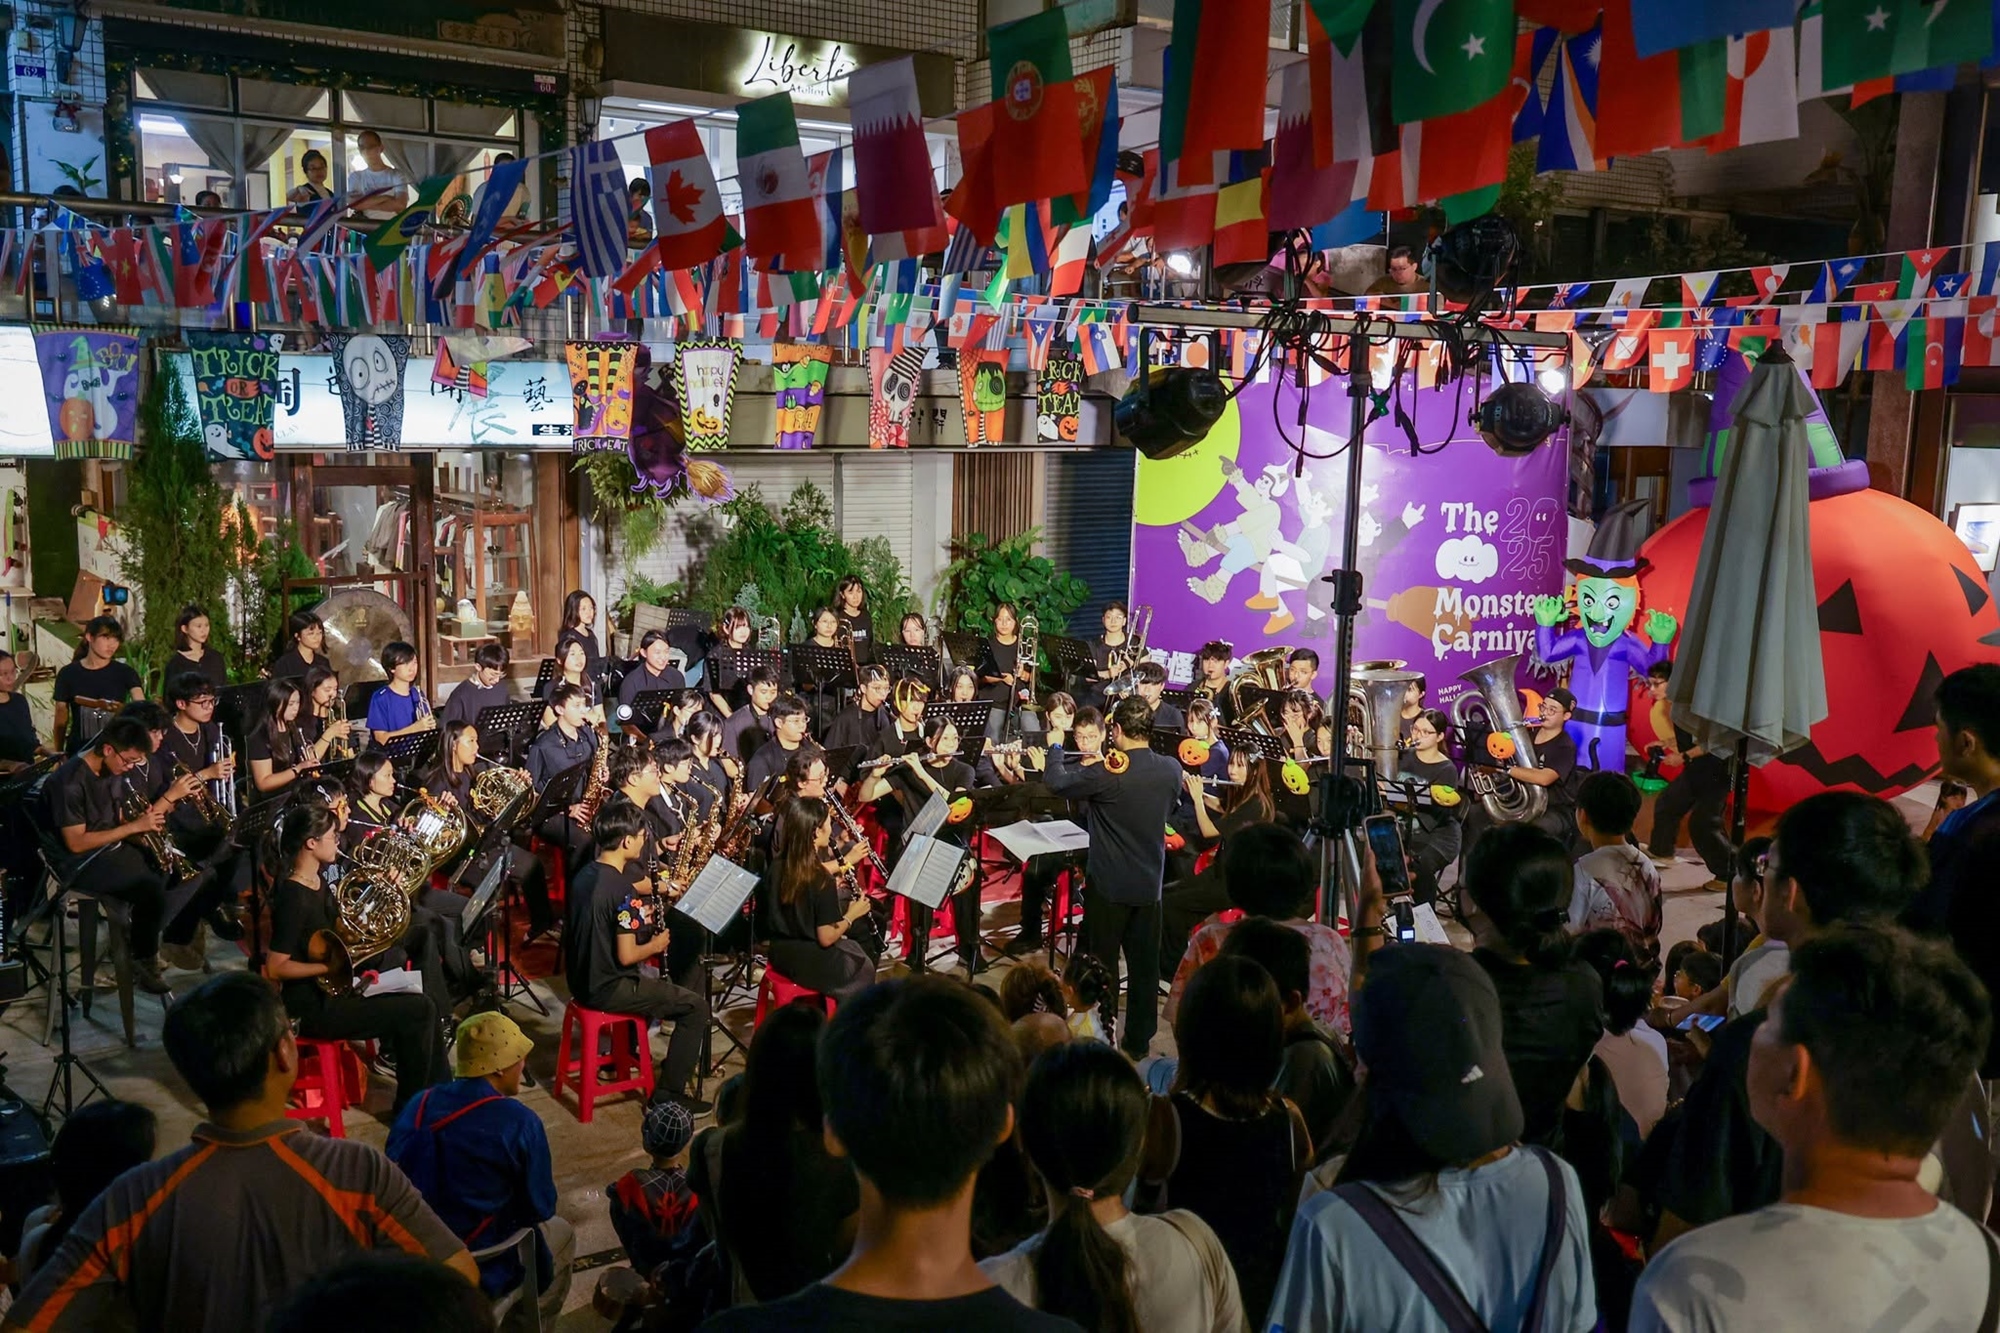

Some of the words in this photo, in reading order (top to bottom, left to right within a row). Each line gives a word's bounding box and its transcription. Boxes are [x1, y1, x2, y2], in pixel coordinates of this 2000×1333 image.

[23, 66, 38, 77] 62
[540, 83, 551, 93] 60
[191, 346, 280, 380] TRICK
[230, 382, 249, 396] OR
[200, 393, 276, 425] TREAT
[1440, 502, 1499, 537] The
[1437, 684, 1462, 696] HAPPY
